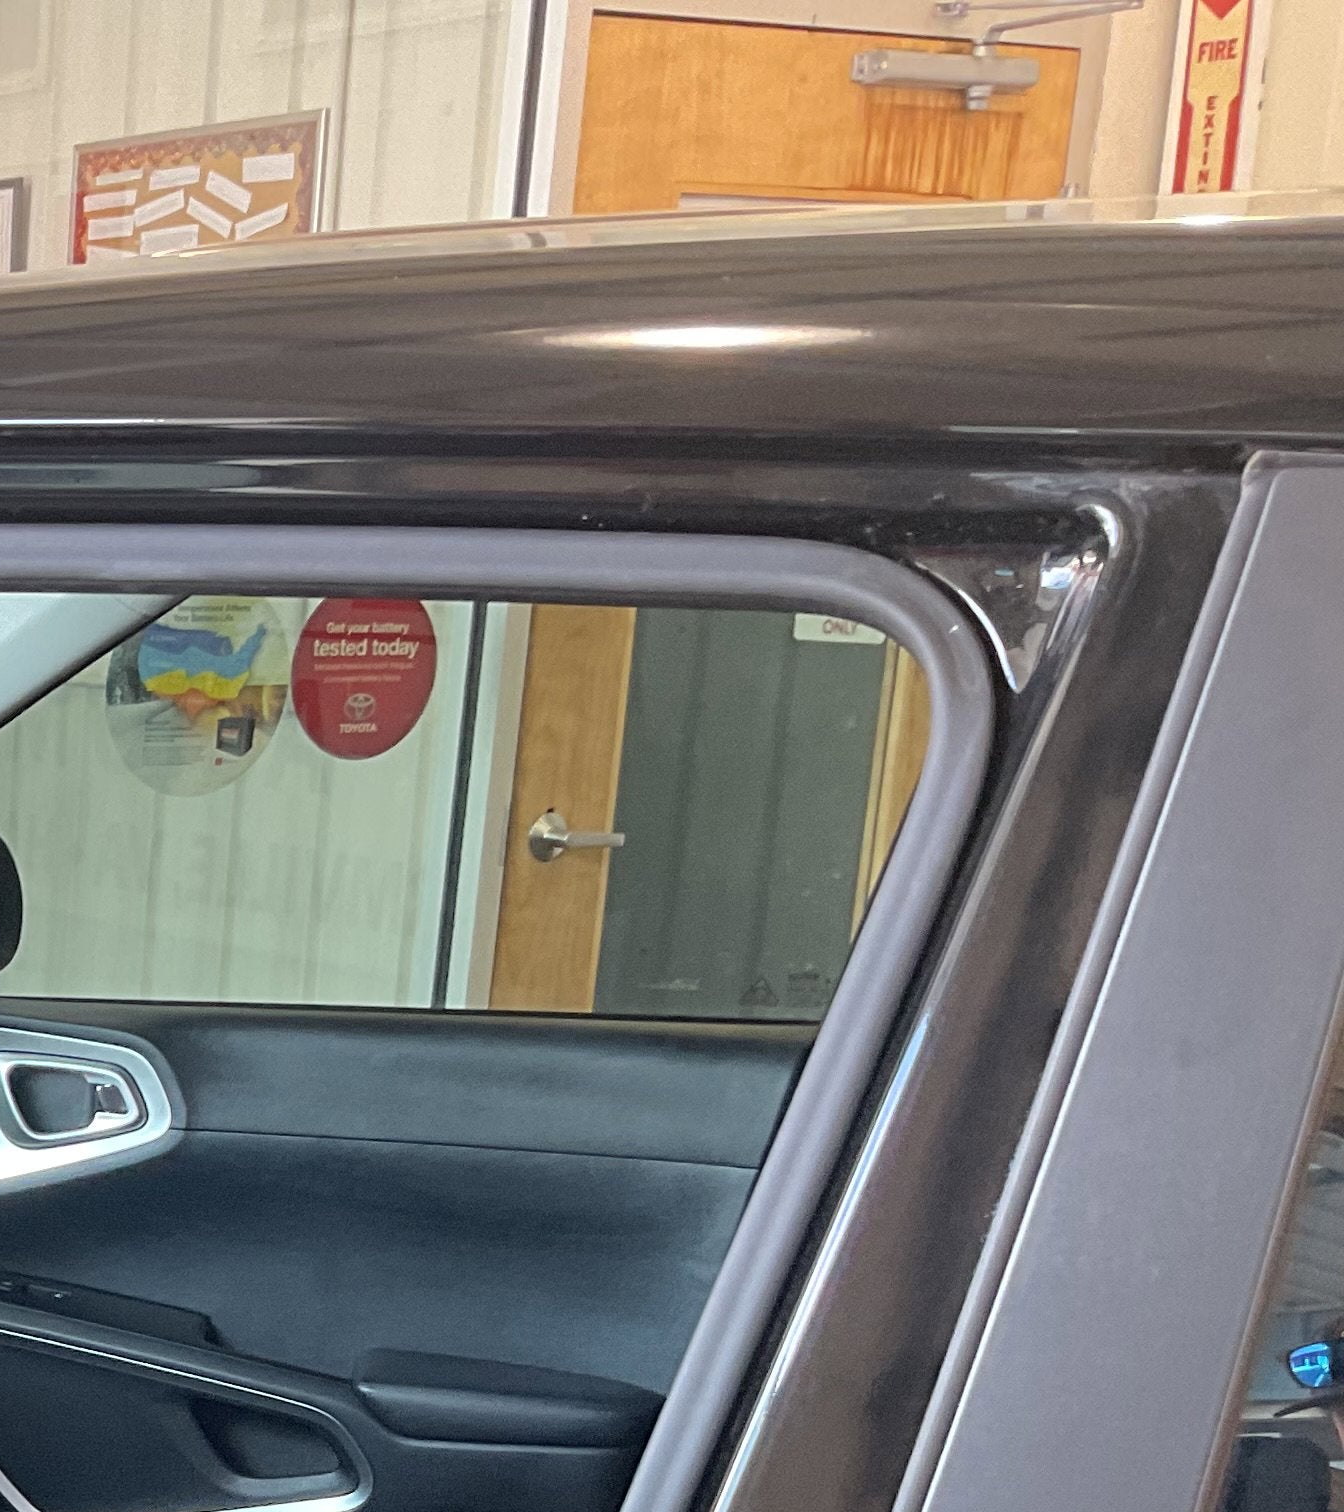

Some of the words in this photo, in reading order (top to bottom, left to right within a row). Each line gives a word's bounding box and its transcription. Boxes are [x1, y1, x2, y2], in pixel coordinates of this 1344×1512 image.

[1198, 38, 1238, 64] FIRE
[326, 622, 345, 634] Get
[348, 623, 370, 636] your
[313, 638, 368, 657] tested
[372, 637, 420, 659] today
[339, 722, 379, 734] TOYOTA
